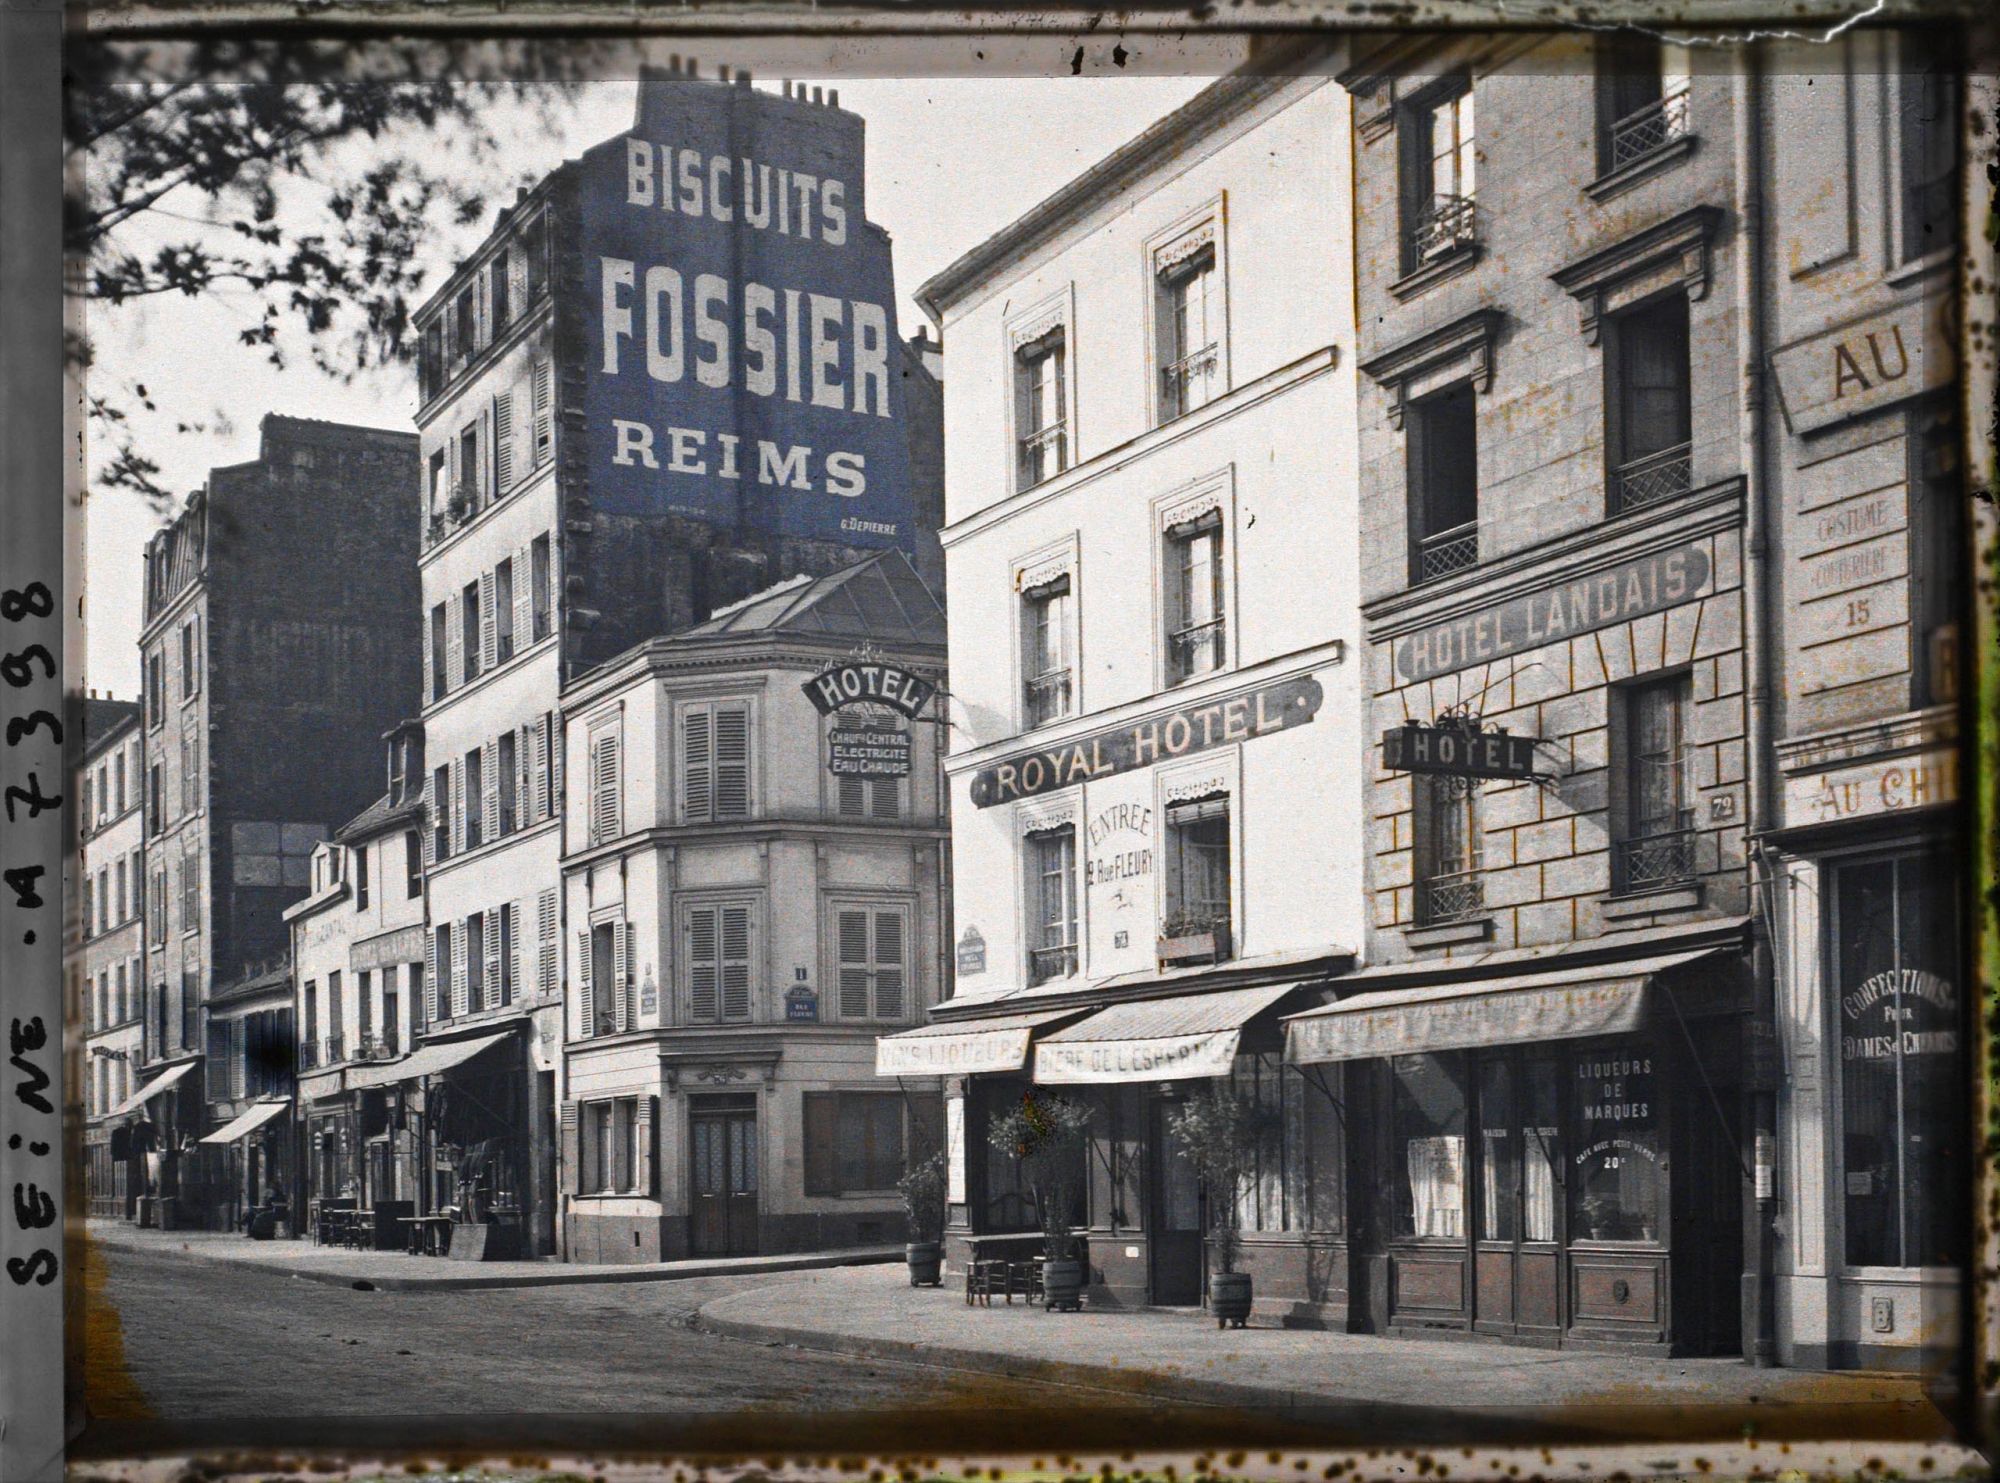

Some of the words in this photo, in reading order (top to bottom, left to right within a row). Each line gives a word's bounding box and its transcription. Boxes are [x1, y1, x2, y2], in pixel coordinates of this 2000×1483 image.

[626, 137, 847, 246] BISCUITS
[600, 256, 892, 418] FOSSIER
[1834, 325, 1909, 400] AU
[612, 419, 867, 497] REIMS
[1412, 613, 1512, 675] HOTEL
[1526, 552, 1687, 642] LANDAIS
[1846, 599, 1870, 627] 15
[816, 667, 920, 709] HOTEL
[833, 759, 858, 773] EAU
[1414, 733, 1523, 770] HOTEL
[997, 740, 1114, 799] ROYAL
[1713, 797, 1732, 818] 72
[1815, 775, 1861, 820] AU
[1115, 848, 1153, 879] FLEURY
[928, 1039, 1023, 1064] LIQUEURS
[1843, 1036, 1892, 1060] DAMES
[1579, 1060, 1651, 1078] LIQUEURS
[1604, 1084, 1622, 1098] DE
[1584, 1103, 1649, 1120] MARQUES
